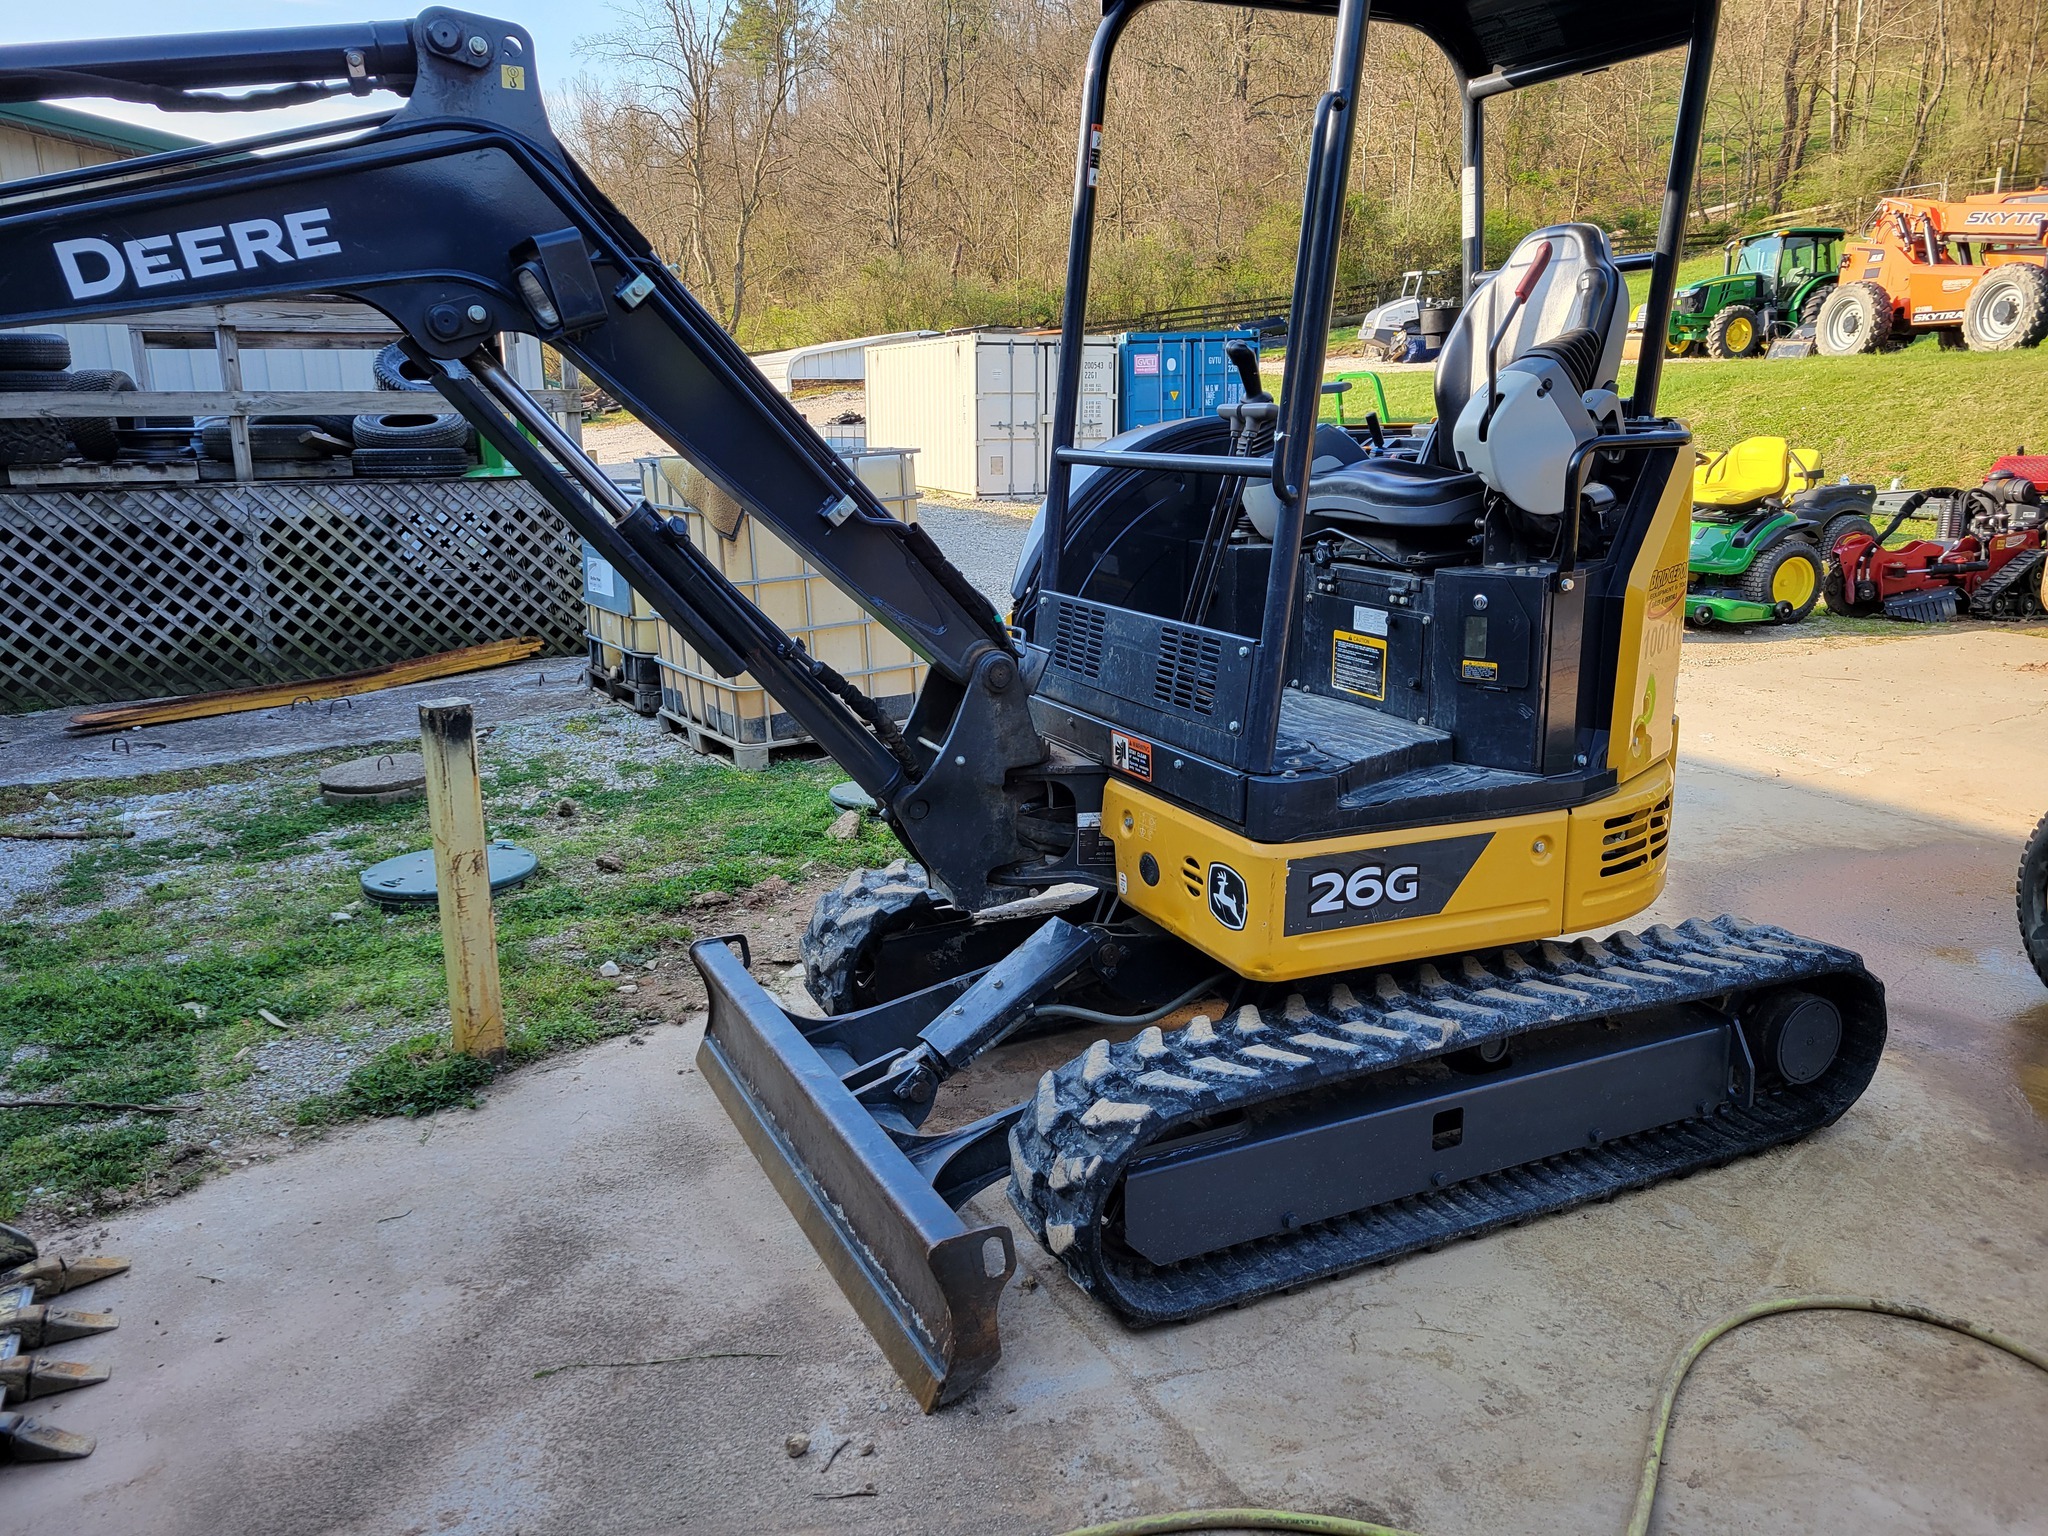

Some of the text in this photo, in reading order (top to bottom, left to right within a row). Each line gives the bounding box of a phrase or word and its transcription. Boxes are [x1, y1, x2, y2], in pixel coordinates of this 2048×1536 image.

[53, 208, 342, 300] DEERE
[1084, 361, 1104, 370] 200543
[1208, 357, 1222, 365] GVTU
[1353, 636, 1370, 645] CAUTION
[1309, 865, 1419, 915] 26G
